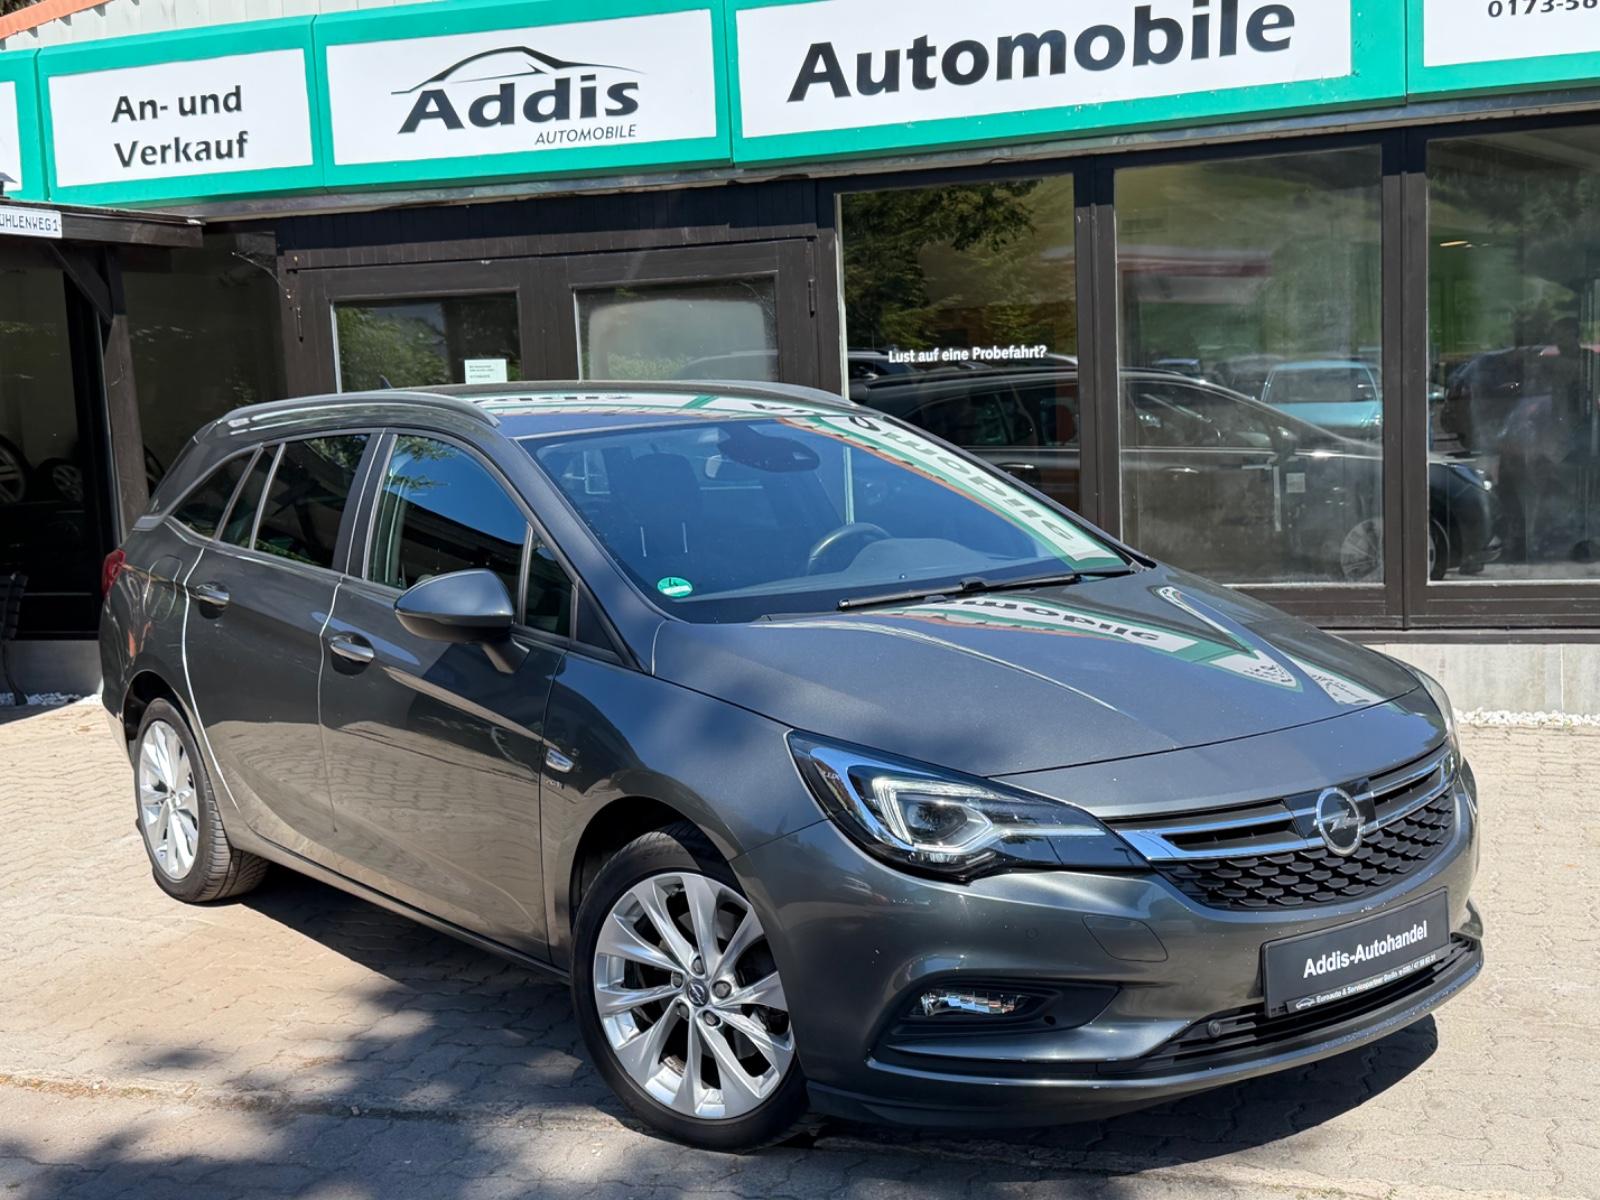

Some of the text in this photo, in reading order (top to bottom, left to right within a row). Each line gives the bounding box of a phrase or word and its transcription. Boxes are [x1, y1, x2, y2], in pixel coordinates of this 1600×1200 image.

[786, 0, 1295, 103] Automobile
[111, 85, 242, 123] An- und
[397, 73, 640, 135] Addis
[113, 130, 249, 168] Verkauf
[534, 123, 638, 146] AUTOMOBILE
[888, 344, 1048, 363] Lust auf eine Probefahrt?
[1303, 920, 1428, 979] Addis-Autohandel
